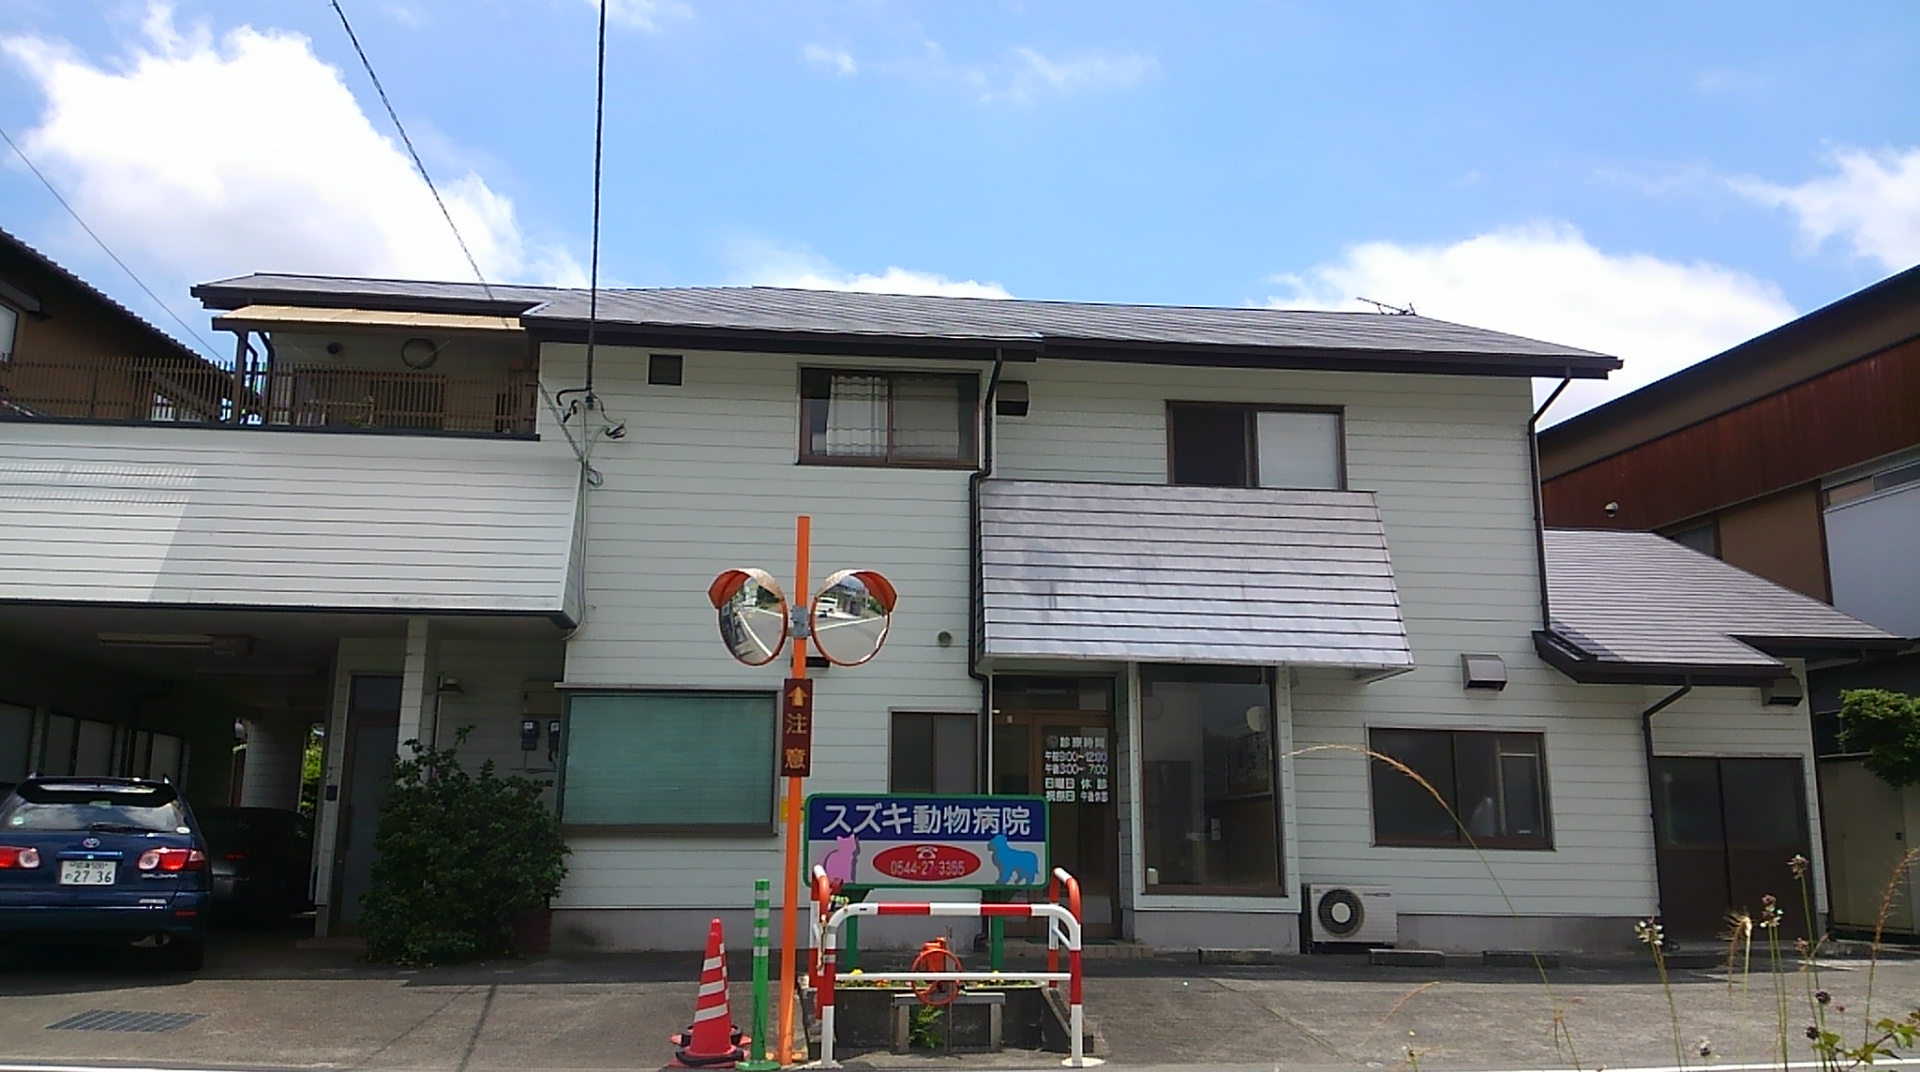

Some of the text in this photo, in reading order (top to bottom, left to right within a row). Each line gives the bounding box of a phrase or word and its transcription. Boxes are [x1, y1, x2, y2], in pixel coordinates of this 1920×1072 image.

[784, 712, 808, 770] 注意
[1059, 736, 1105, 749] 診療時間
[822, 802, 1031, 836] スズキ動物病院
